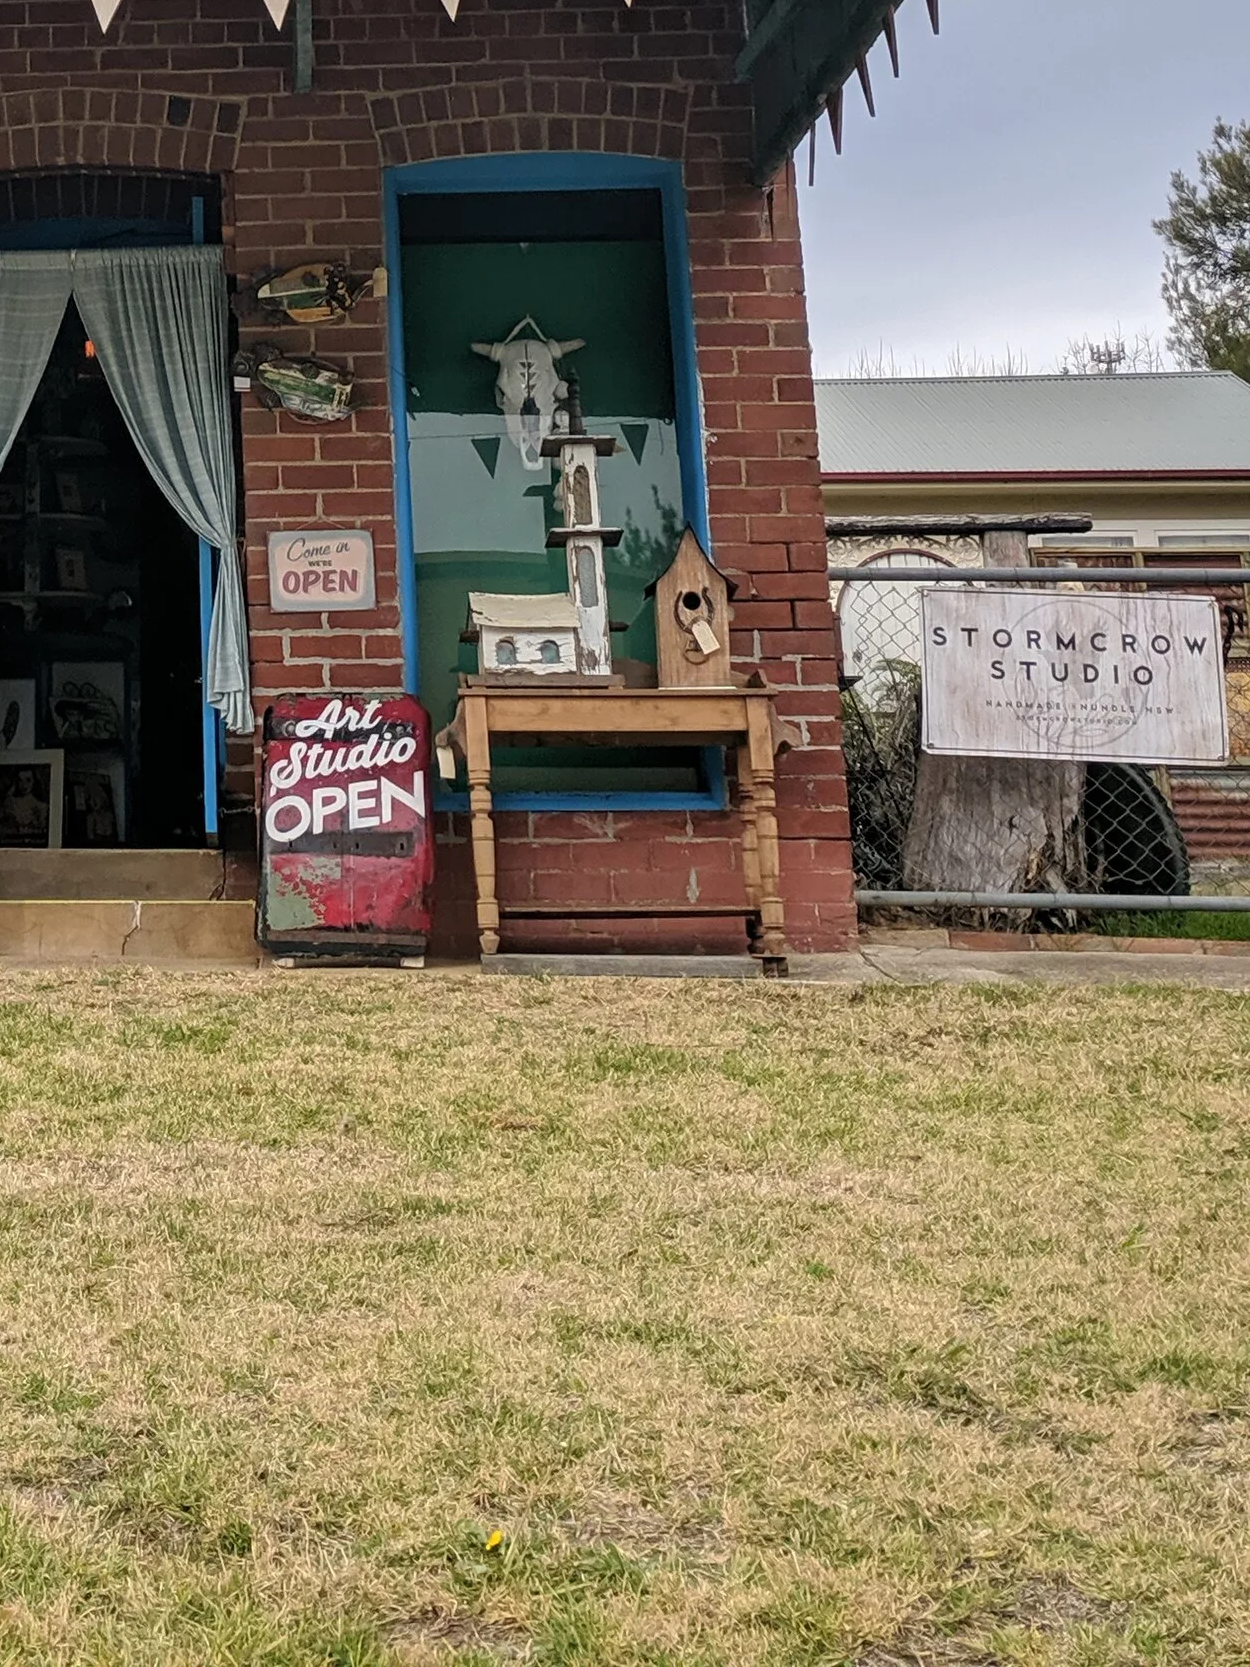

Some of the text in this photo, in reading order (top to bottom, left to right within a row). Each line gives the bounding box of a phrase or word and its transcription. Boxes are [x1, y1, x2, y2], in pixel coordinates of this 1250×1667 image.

[286, 537, 351, 562] Come in
[282, 569, 358, 594] OPEN
[932, 626, 1207, 655] STORMCROW
[990, 660, 1154, 685] STUDIO
[295, 699, 383, 738] Art
[985, 700, 1061, 710] HANDMADE
[1080, 703, 1135, 713] NUNDLE
[1145, 706, 1174, 715] NSW
[269, 732, 417, 797] Studio
[265, 770, 426, 842] OPEN
